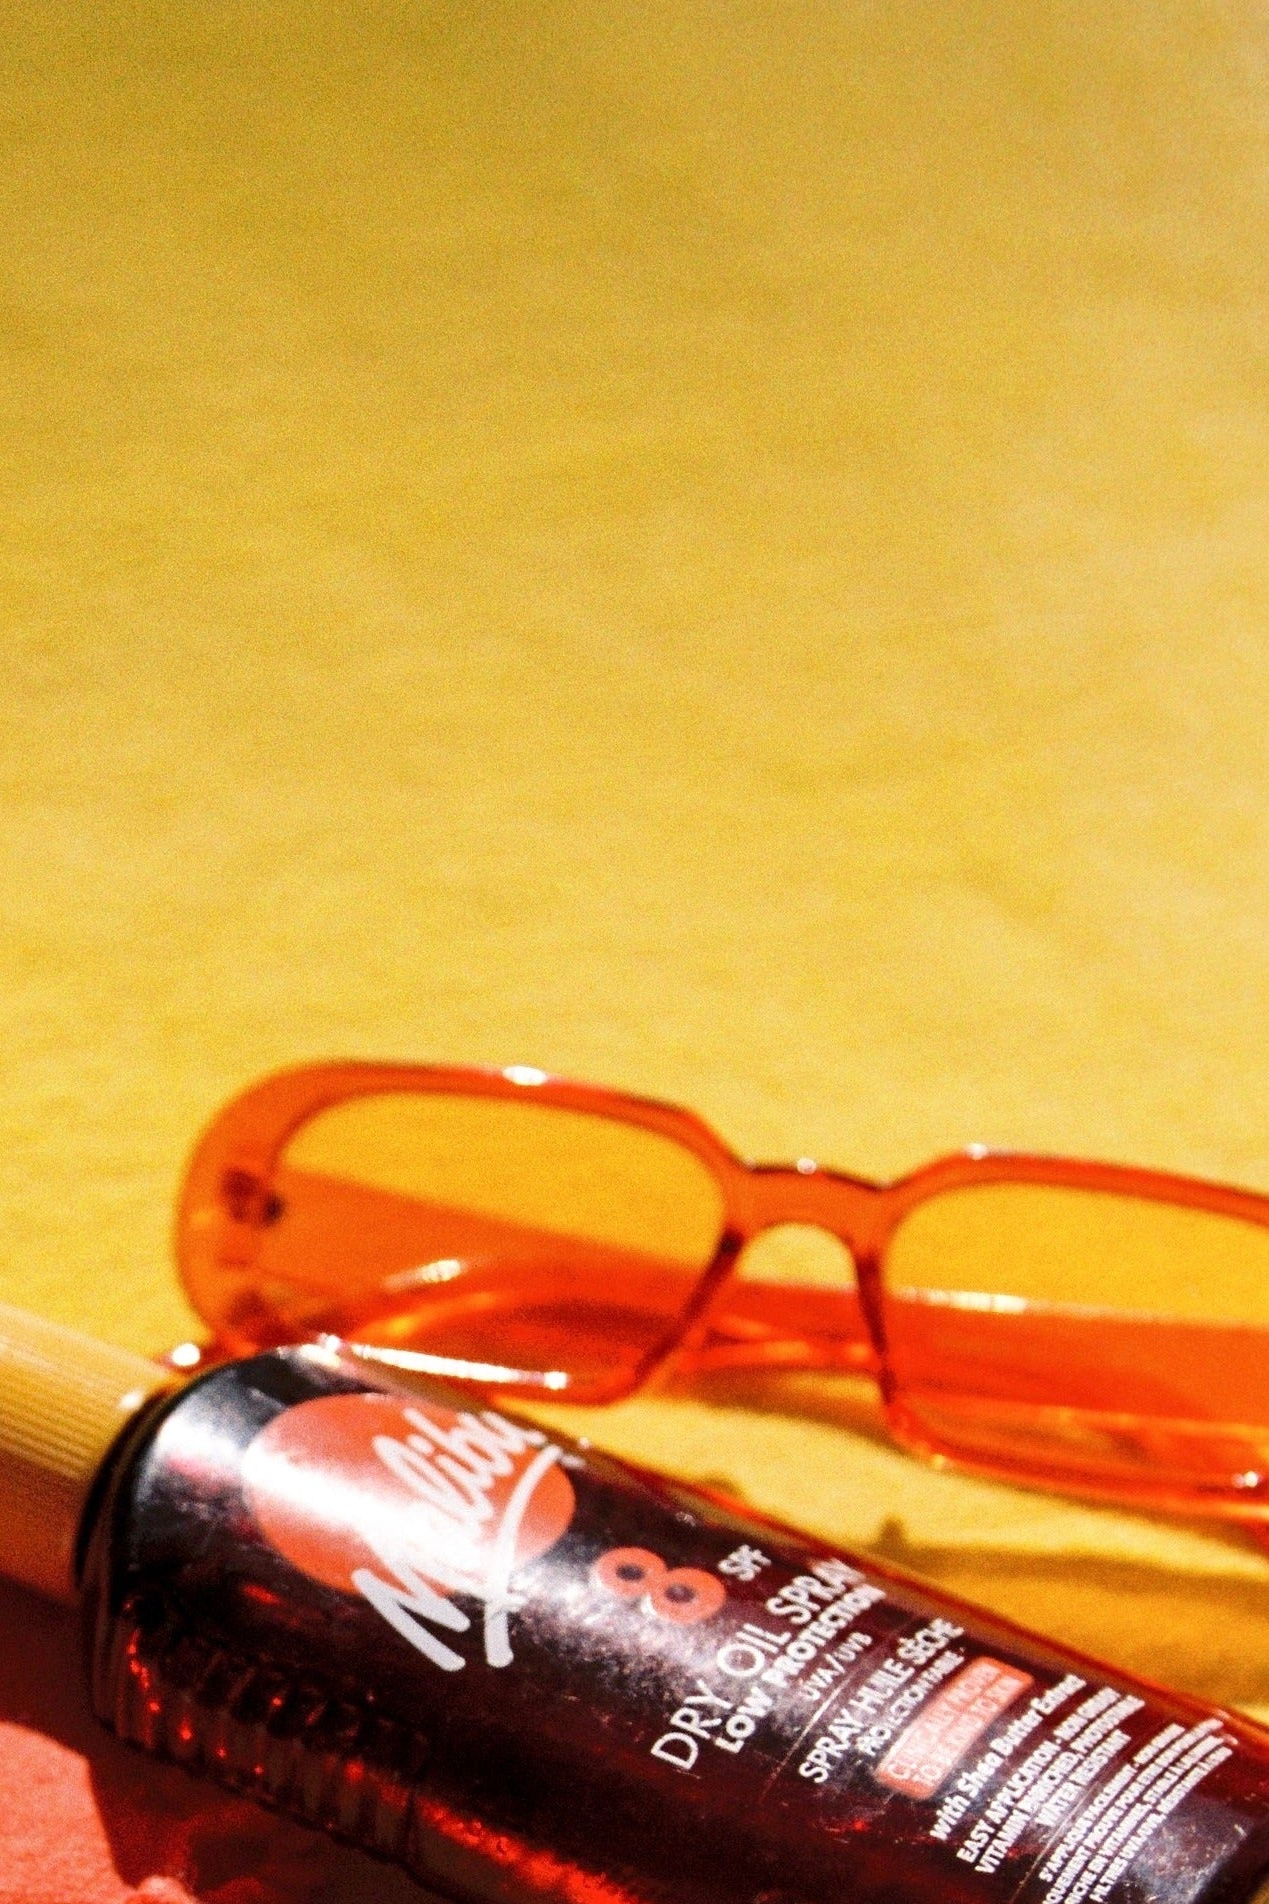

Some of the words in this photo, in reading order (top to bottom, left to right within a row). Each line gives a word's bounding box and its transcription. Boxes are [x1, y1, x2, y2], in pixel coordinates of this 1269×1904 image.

[352, 1409, 547, 1670] Mlibu
[592, 1547, 727, 1625] 8
[718, 1544, 772, 1582] SPF
[650, 1677, 732, 1770] DRY
[716, 1623, 793, 1686] OIL
[766, 1560, 862, 1624] SPRAY
[714, 1684, 776, 1754] LOW
[760, 1583, 886, 1691] PROTECTION
[798, 1632, 872, 1702] UVA/UVB
[798, 1706, 866, 1784] SPRAY
[858, 1657, 915, 1717] HUILE
[929, 1794, 971, 1841] with
[956, 1751, 1006, 1800] Shea
[989, 1708, 1043, 1757] Butter
[956, 1818, 995, 1863] EASY
[984, 1740, 1061, 1825] APPLICATION
[1032, 1780, 1086, 1828] WATER
[974, 1808, 1033, 1873] VITAMIN
